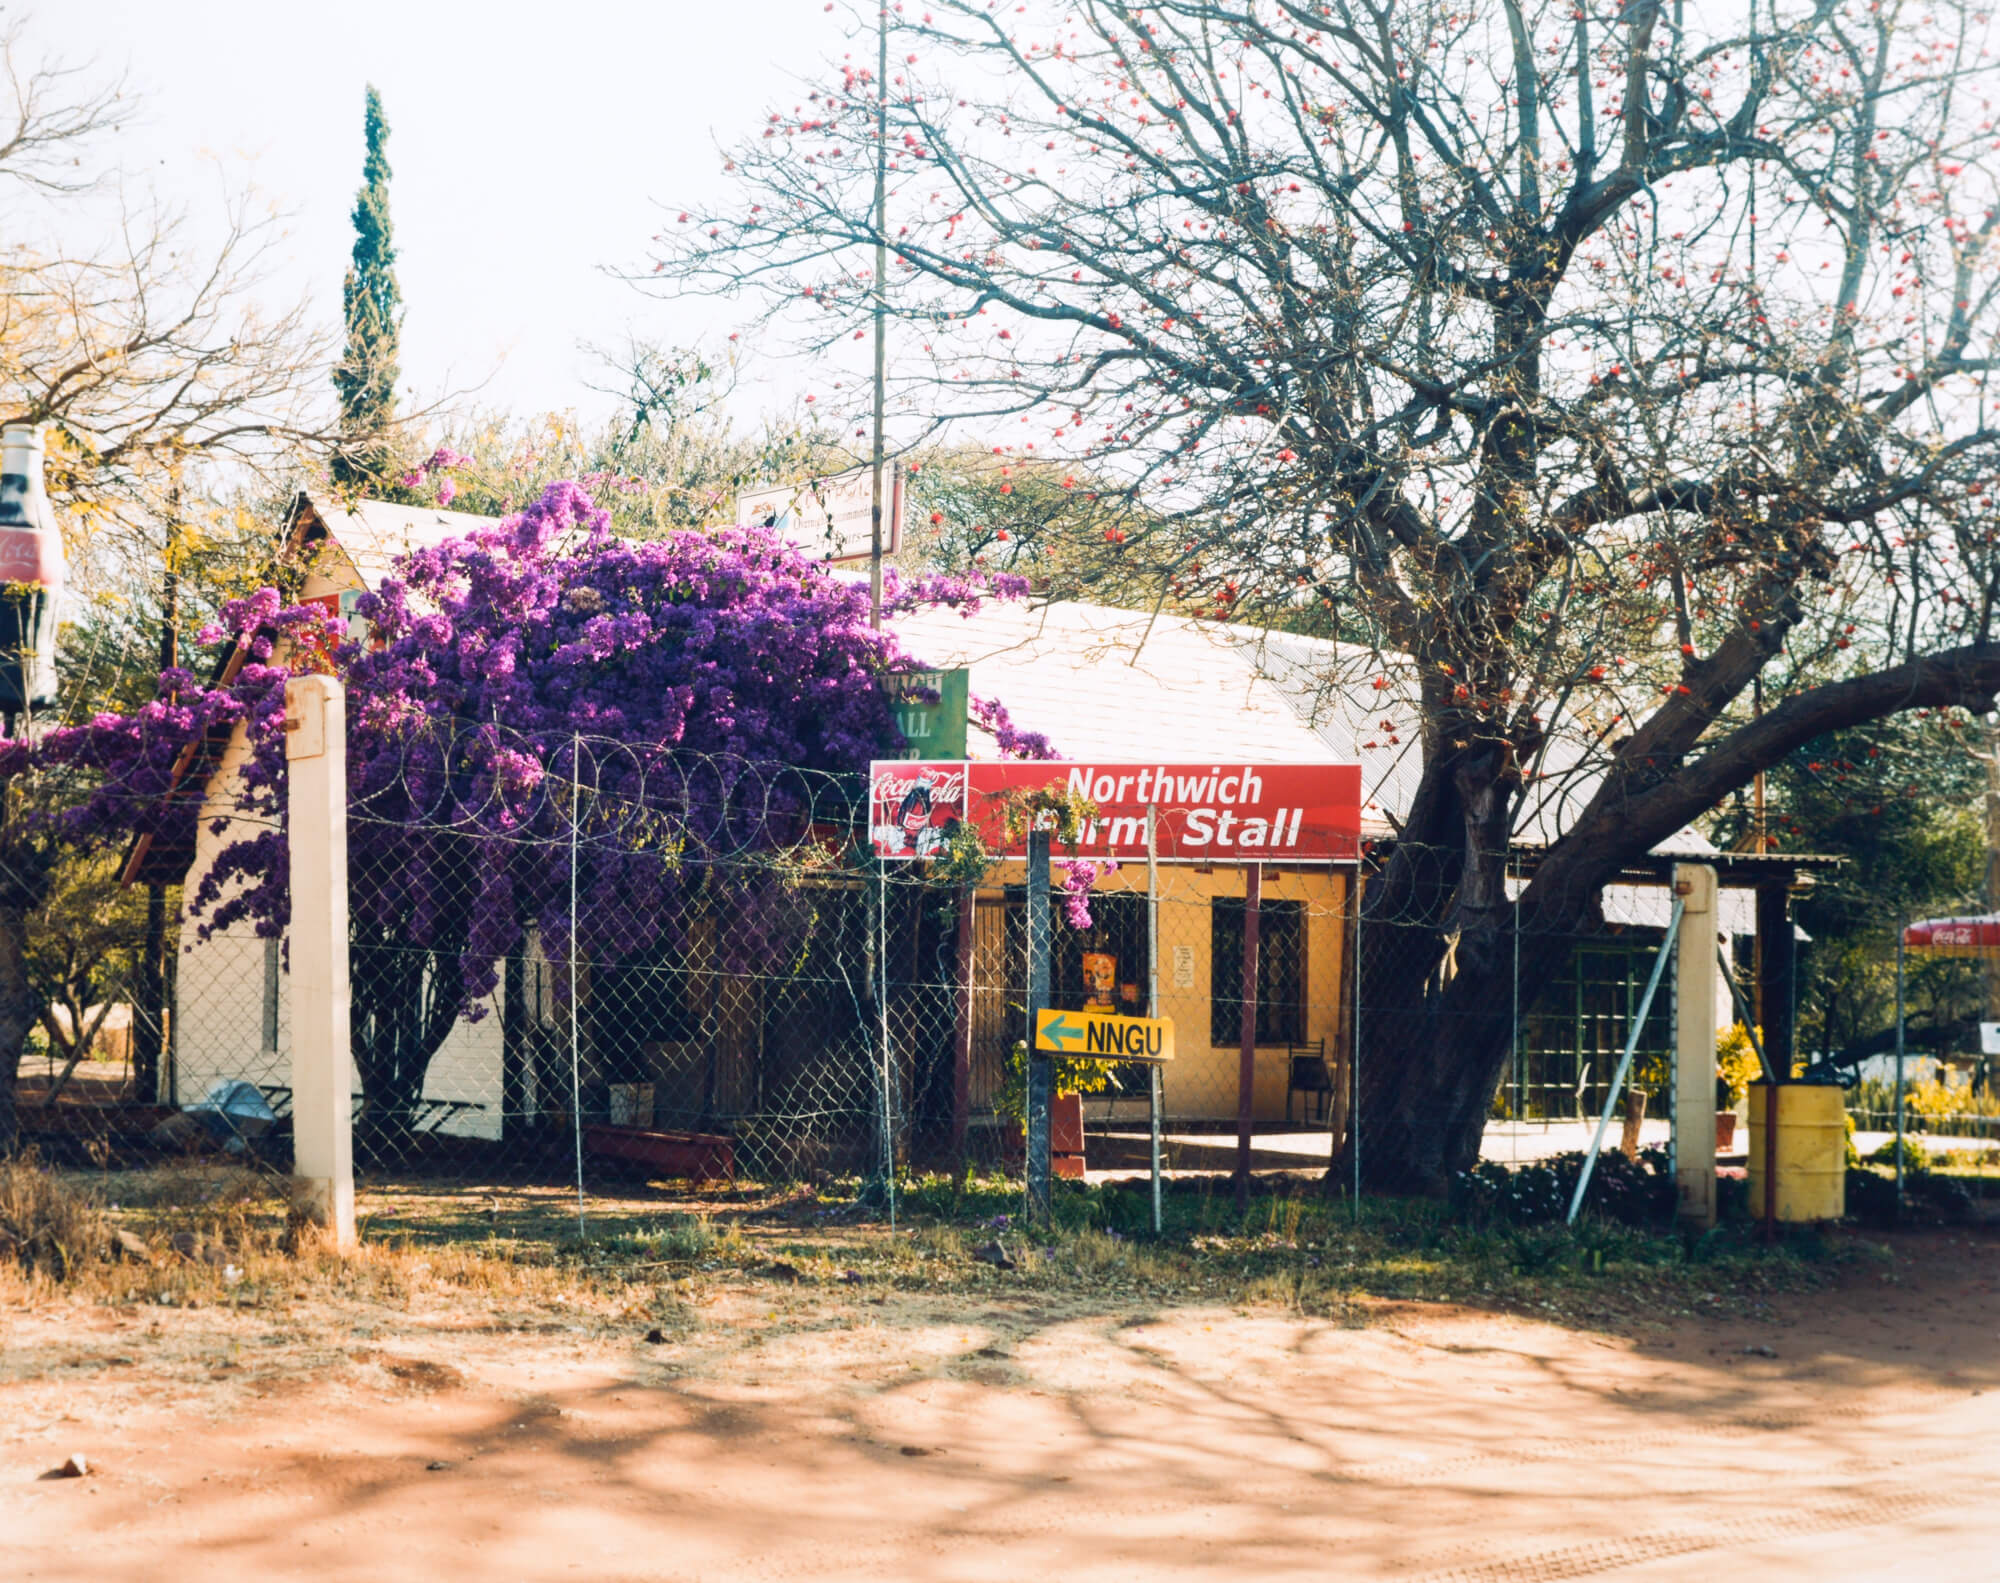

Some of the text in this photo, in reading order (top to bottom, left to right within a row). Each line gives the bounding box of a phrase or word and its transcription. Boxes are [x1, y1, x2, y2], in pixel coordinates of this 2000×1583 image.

[1067, 766, 1263, 804] Northwich
[1181, 807, 1304, 847] Stall
[1086, 1020, 1163, 1056] NNGU
